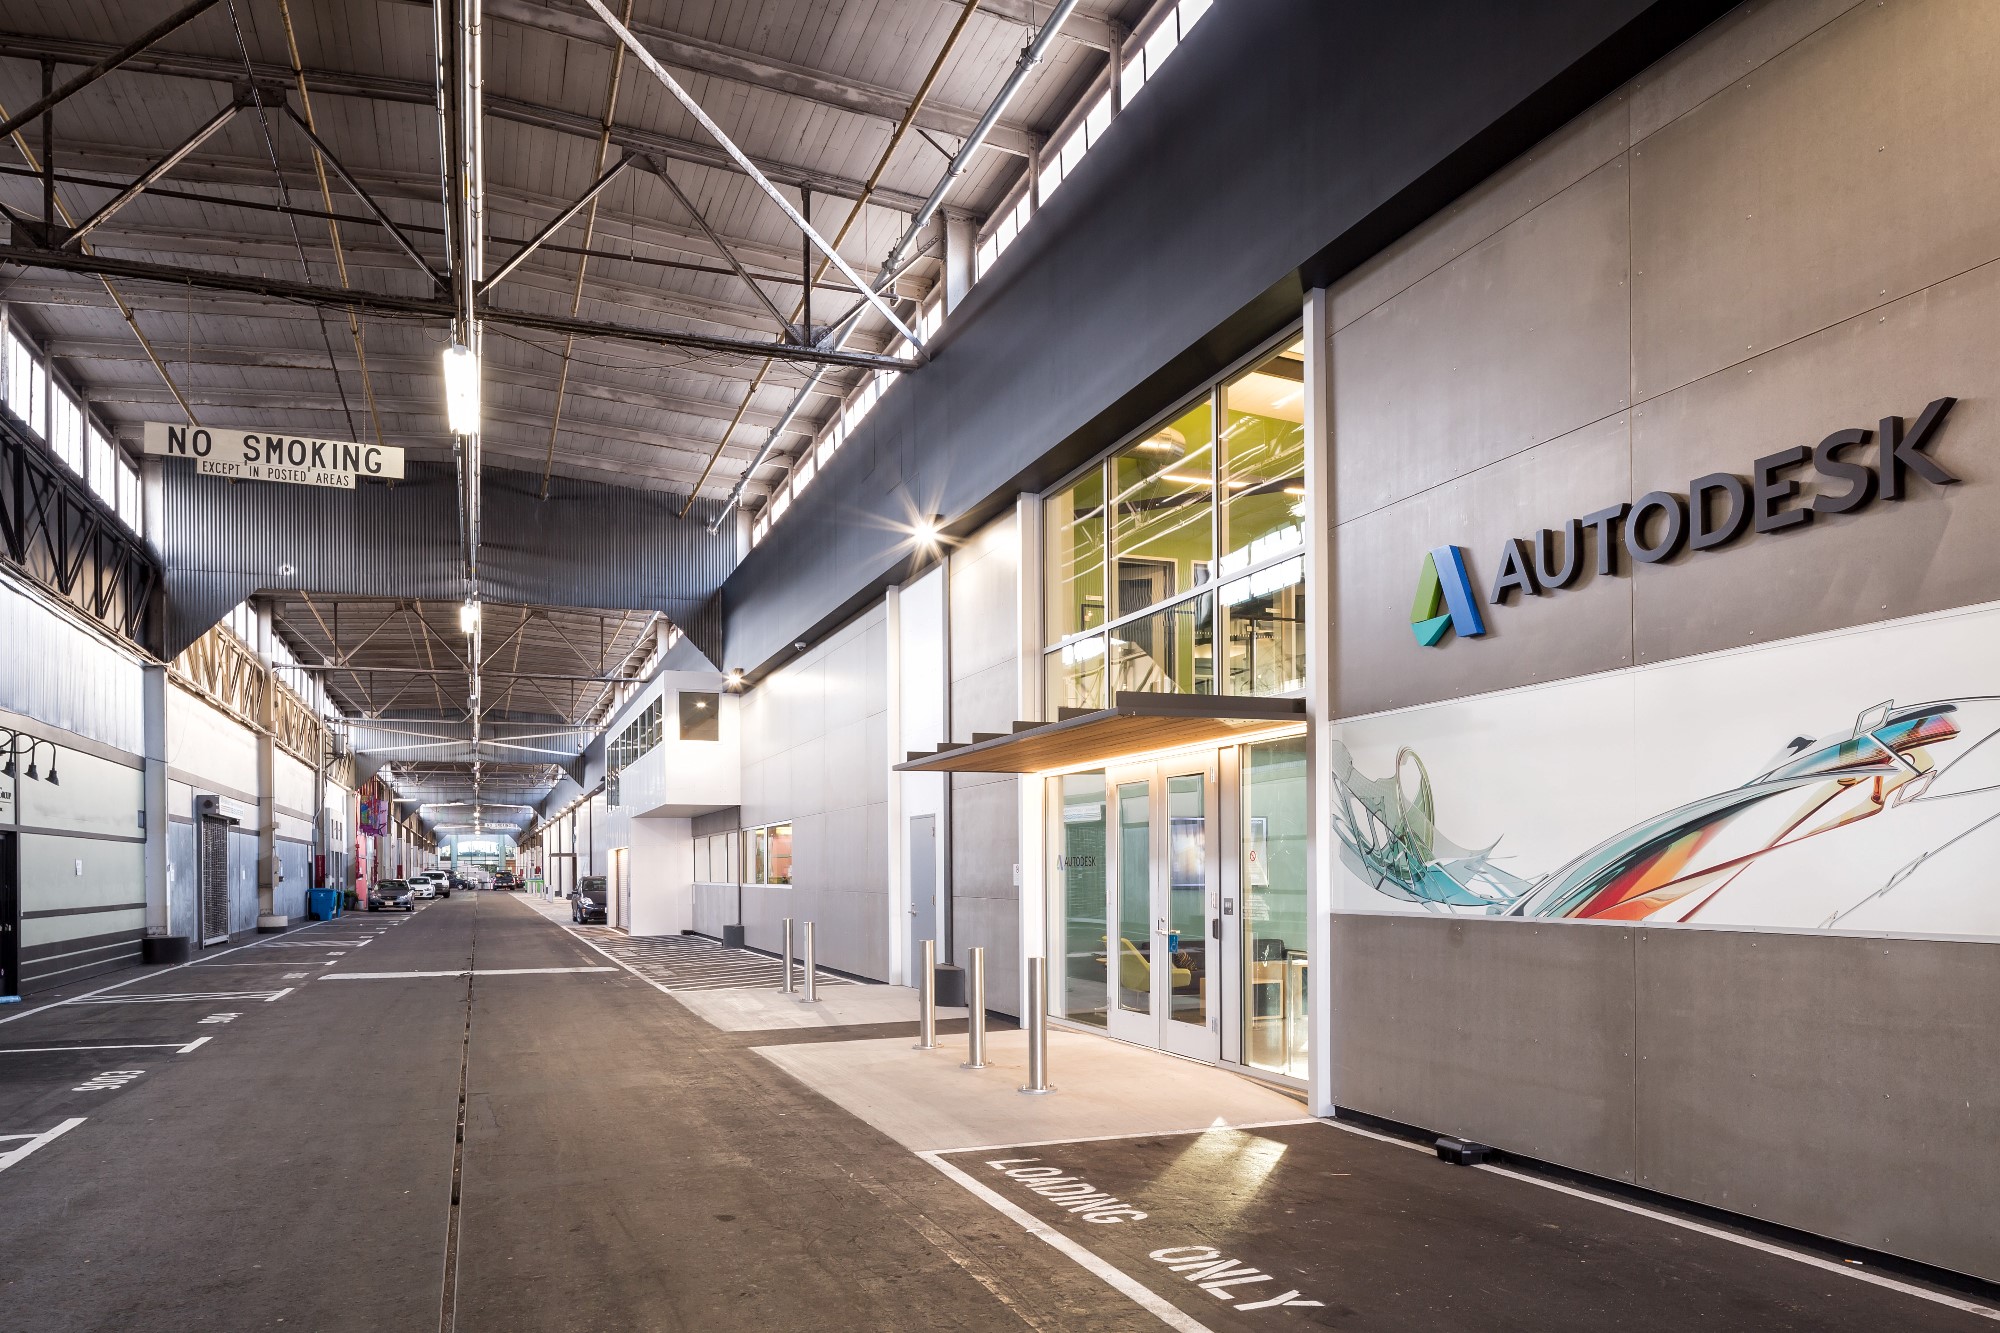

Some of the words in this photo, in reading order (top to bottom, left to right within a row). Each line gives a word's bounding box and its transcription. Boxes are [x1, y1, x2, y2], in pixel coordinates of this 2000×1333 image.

[168, 426, 212, 457] NO
[243, 434, 382, 474] SMOKING
[202, 460, 241, 476] EXCEPT
[250, 465, 260, 478] IN
[268, 467, 307, 482] POSTED
[315, 472, 349, 487] AREAS
[1489, 396, 1963, 605] AUTODESK
[1064, 856, 1097, 867] AUTODESK
[985, 1157, 1149, 1225] LOADING
[1149, 1245, 1325, 1311] ONLY
